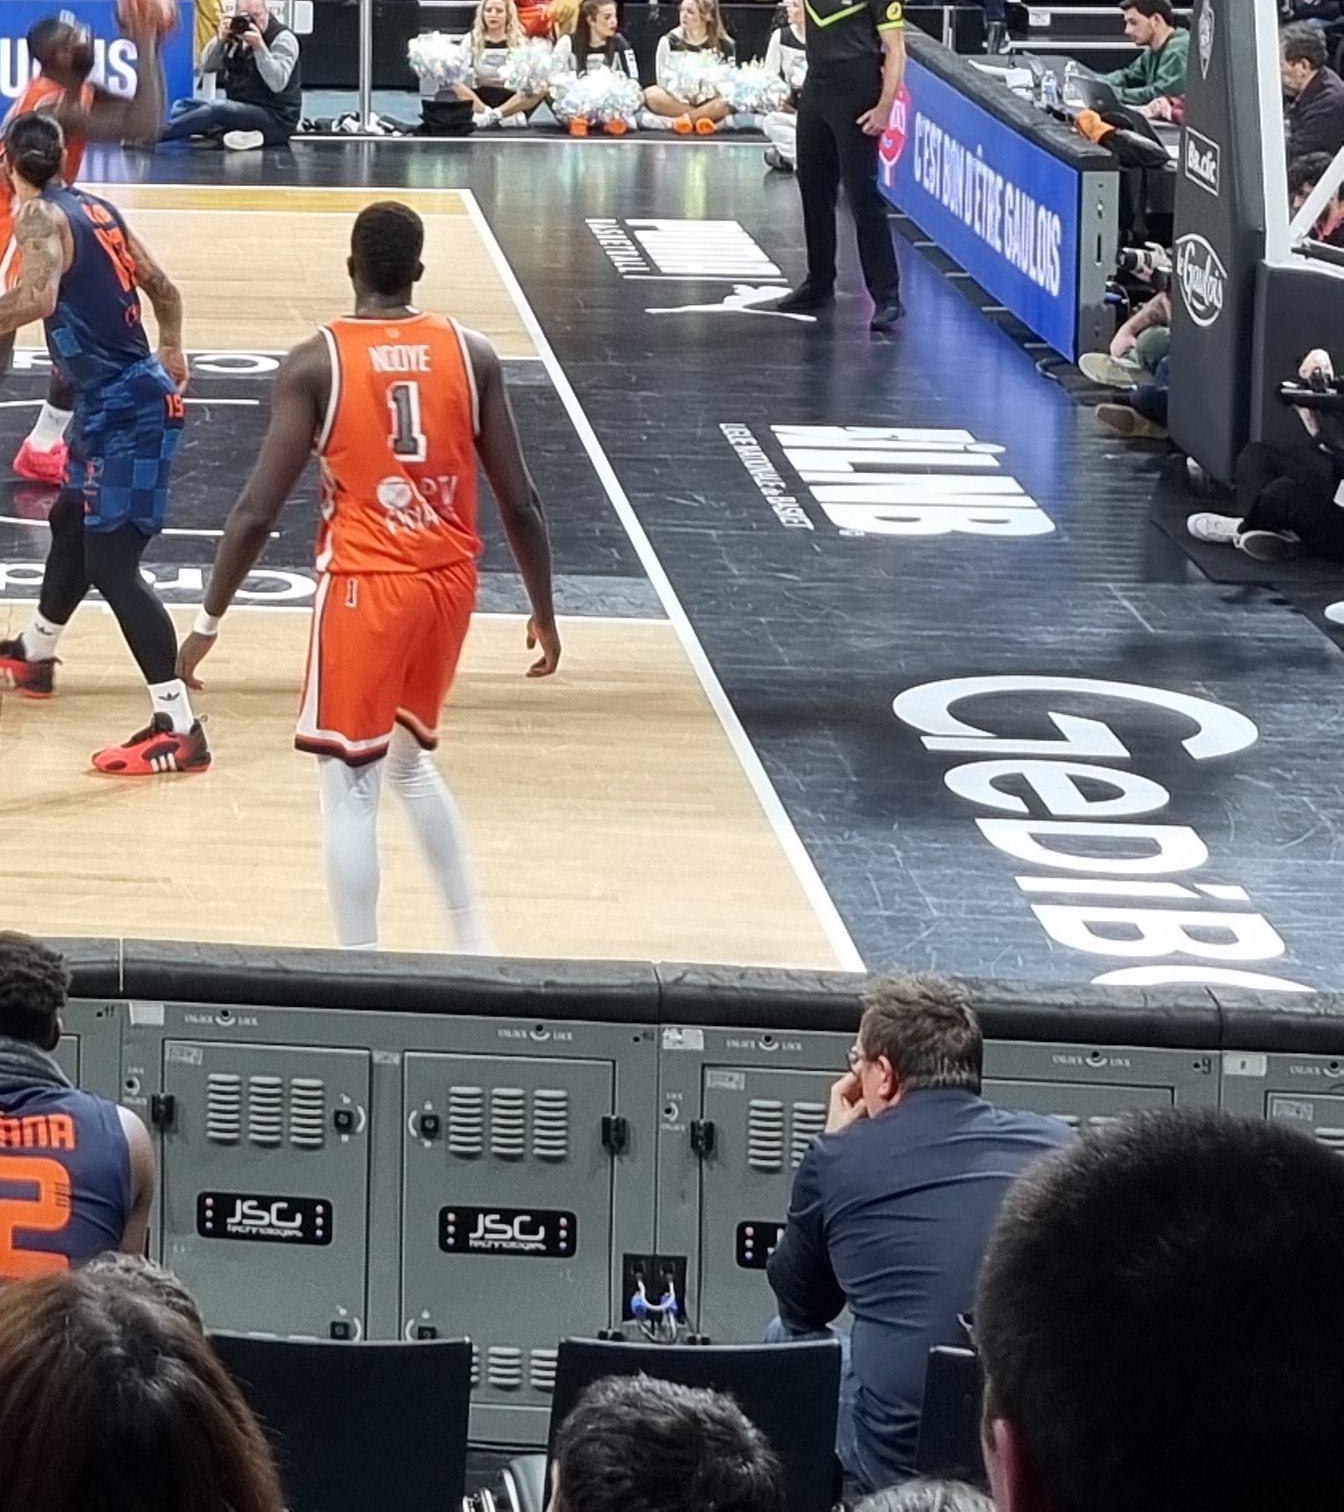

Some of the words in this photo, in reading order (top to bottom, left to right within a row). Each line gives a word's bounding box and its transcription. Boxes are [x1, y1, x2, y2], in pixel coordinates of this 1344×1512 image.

[942, 134, 965, 220] BON
[1003, 181, 1062, 298] GAULOIS
[386, 381, 427, 463] 1
[344, 578, 359, 607] 1
